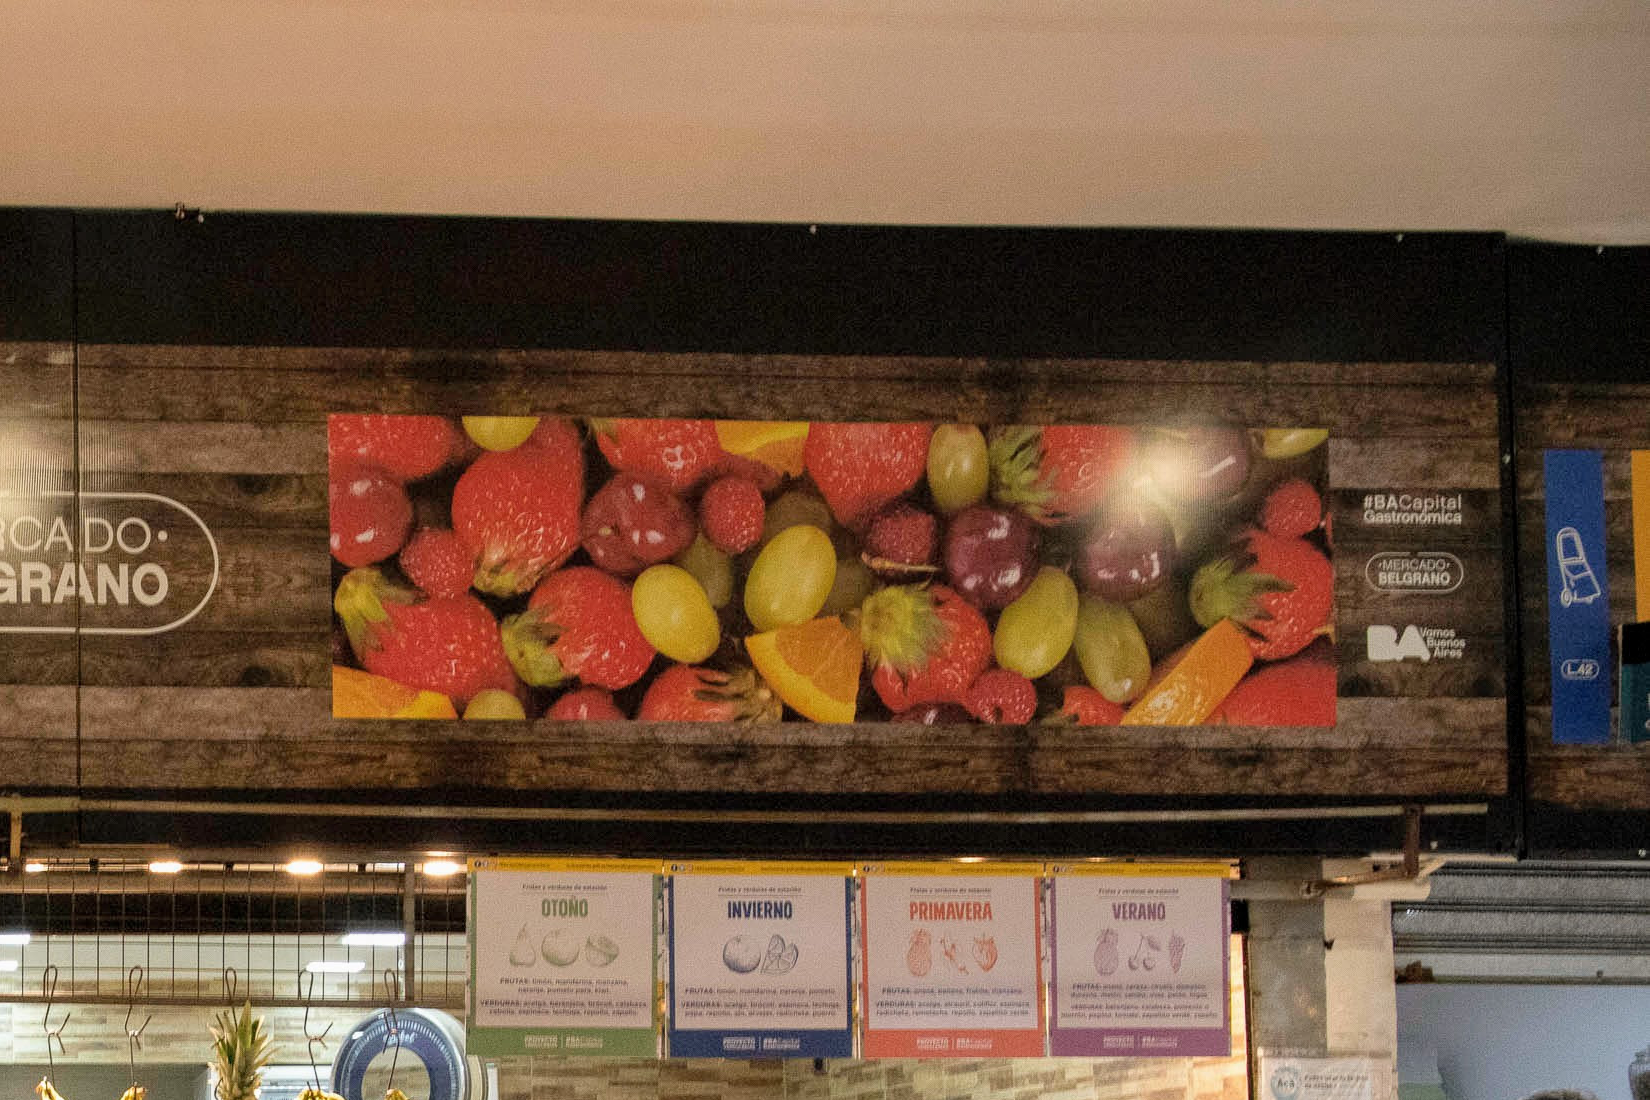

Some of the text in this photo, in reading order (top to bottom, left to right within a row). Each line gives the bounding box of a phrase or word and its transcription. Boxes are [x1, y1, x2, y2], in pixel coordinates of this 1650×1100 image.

[1363, 494, 1462, 512] #BACapital
[1363, 507, 1462, 525] Gastronómica
[1382, 558, 1446, 572] MERCADO
[1379, 571, 1451, 586] BELGRANO
[1420, 627, 1456, 638] Vamos
[1367, 624, 1431, 662] BA
[1427, 637, 1466, 648] Buenos
[1433, 647, 1463, 658] Aires
[542, 895, 589, 918] OTOÑO
[727, 900, 793, 919] INVIERNO
[909, 901, 993, 921] PRIMAVERA
[1111, 901, 1166, 921] VERANO
